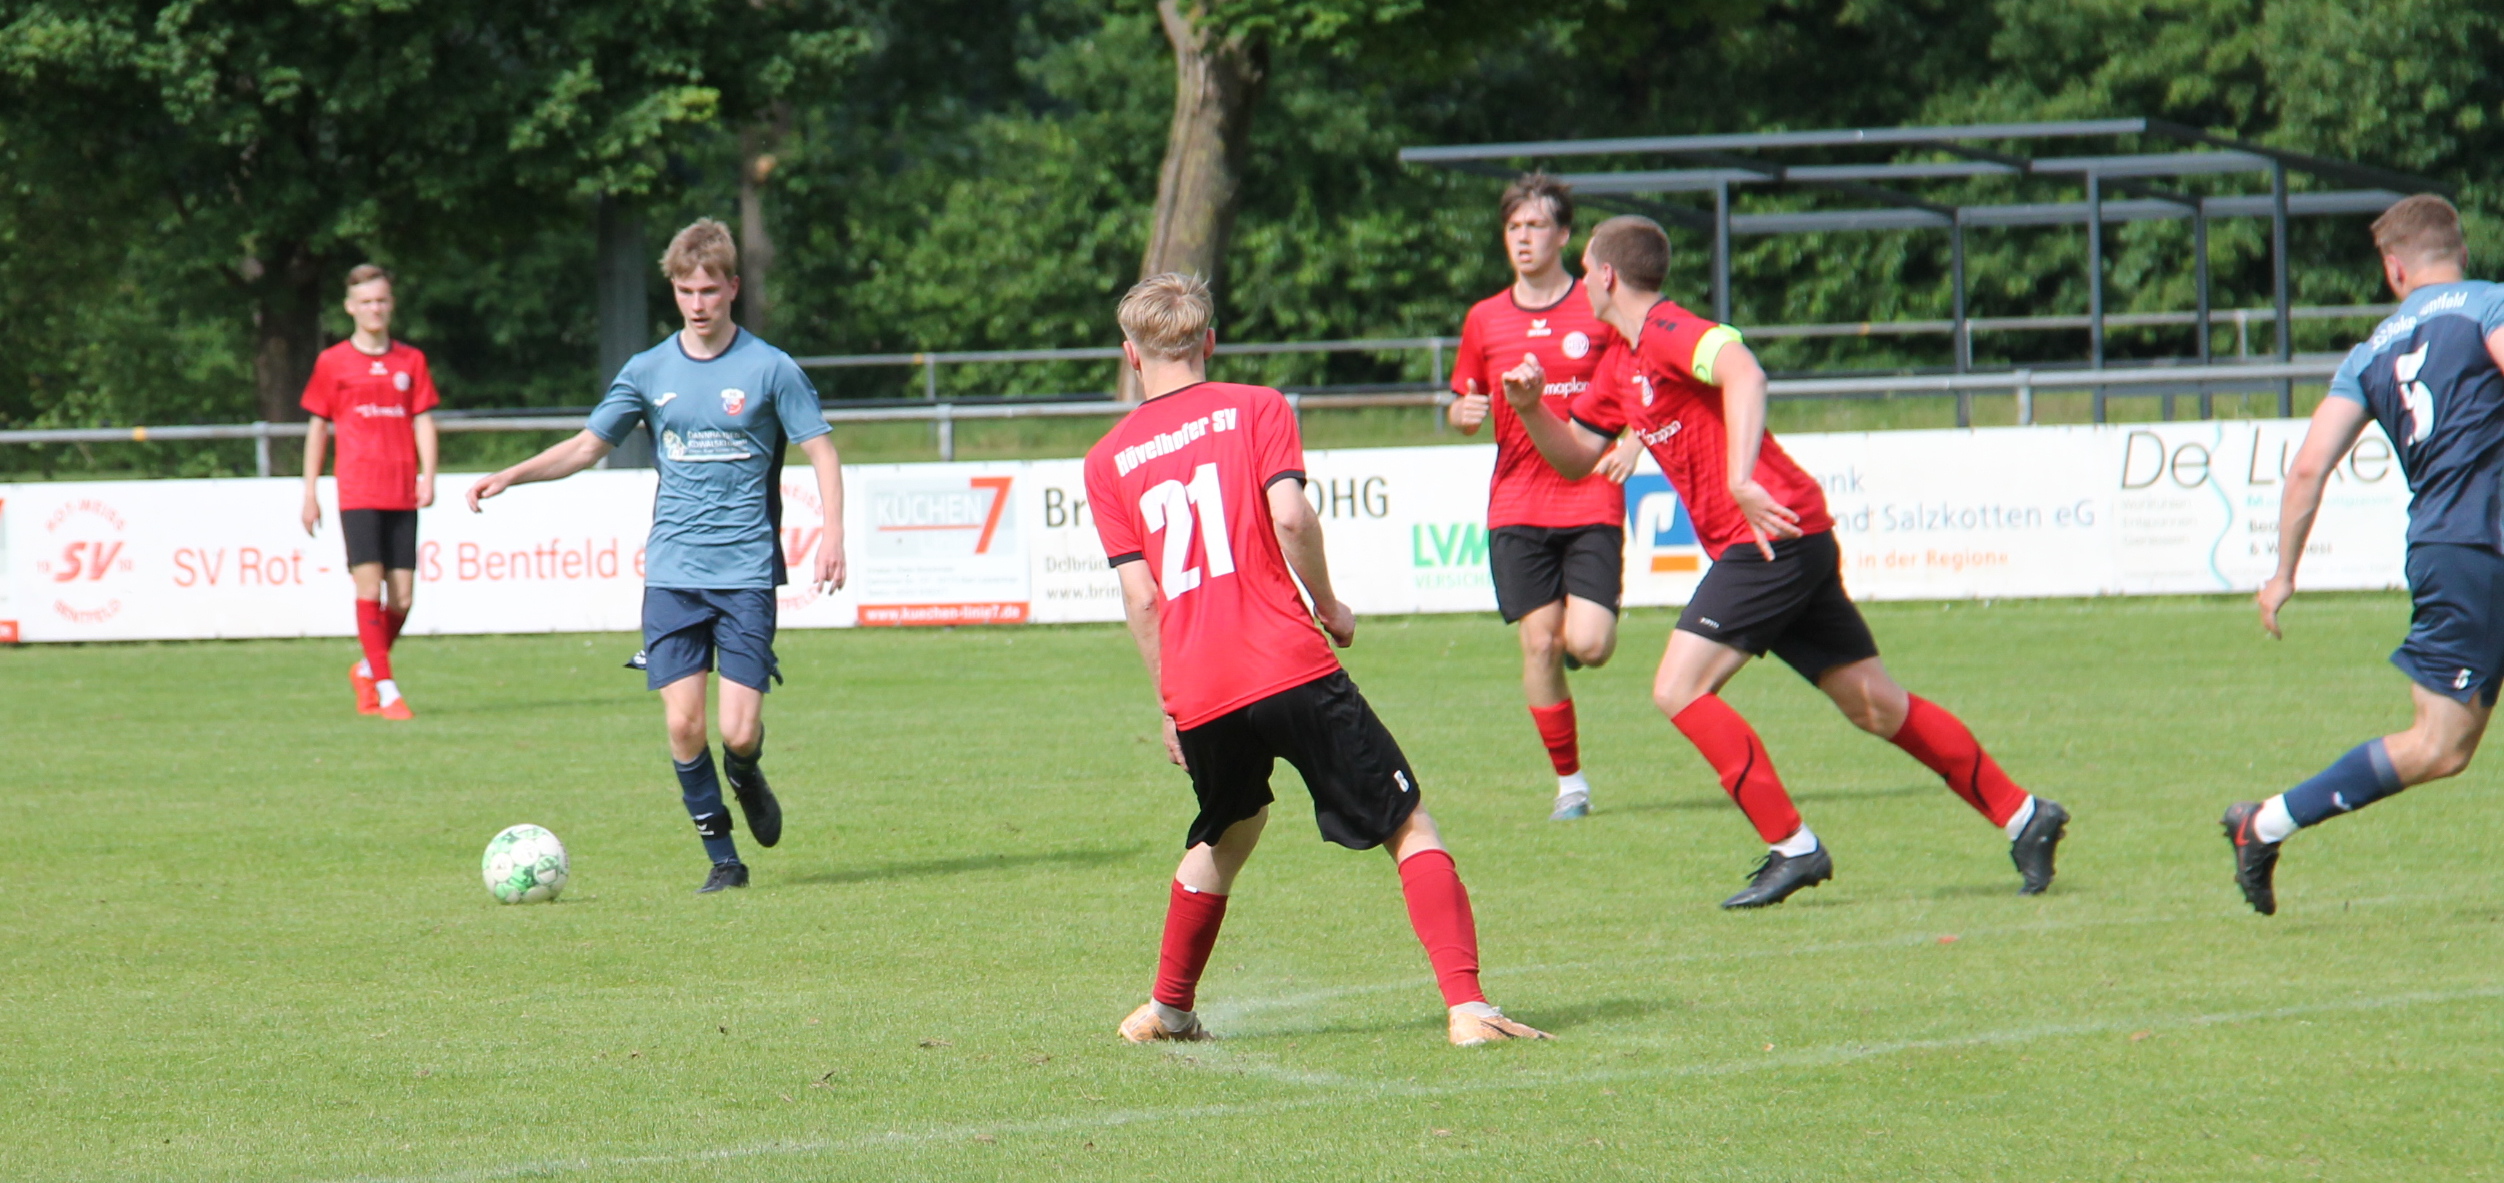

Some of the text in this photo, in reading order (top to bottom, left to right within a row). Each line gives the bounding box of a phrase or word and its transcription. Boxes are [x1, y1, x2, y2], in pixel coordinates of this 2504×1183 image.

[1114, 408, 1237, 478] Hövelhofer SV
[2122, 424, 2392, 489] De Lue
[878, 490, 982, 527] KÜCHEN
[970, 477, 1014, 554] 7
[1139, 462, 1234, 600] 21
[1883, 500, 2042, 532] Salzkotten
[2056, 499, 2096, 528] eG
[54, 541, 125, 583] SV
[173, 548, 225, 587] SV
[240, 546, 303, 585] Rot
[458, 537, 618, 582] Bentfeld
[1859, 553, 1876, 569] in
[1885, 549, 1917, 568] der
